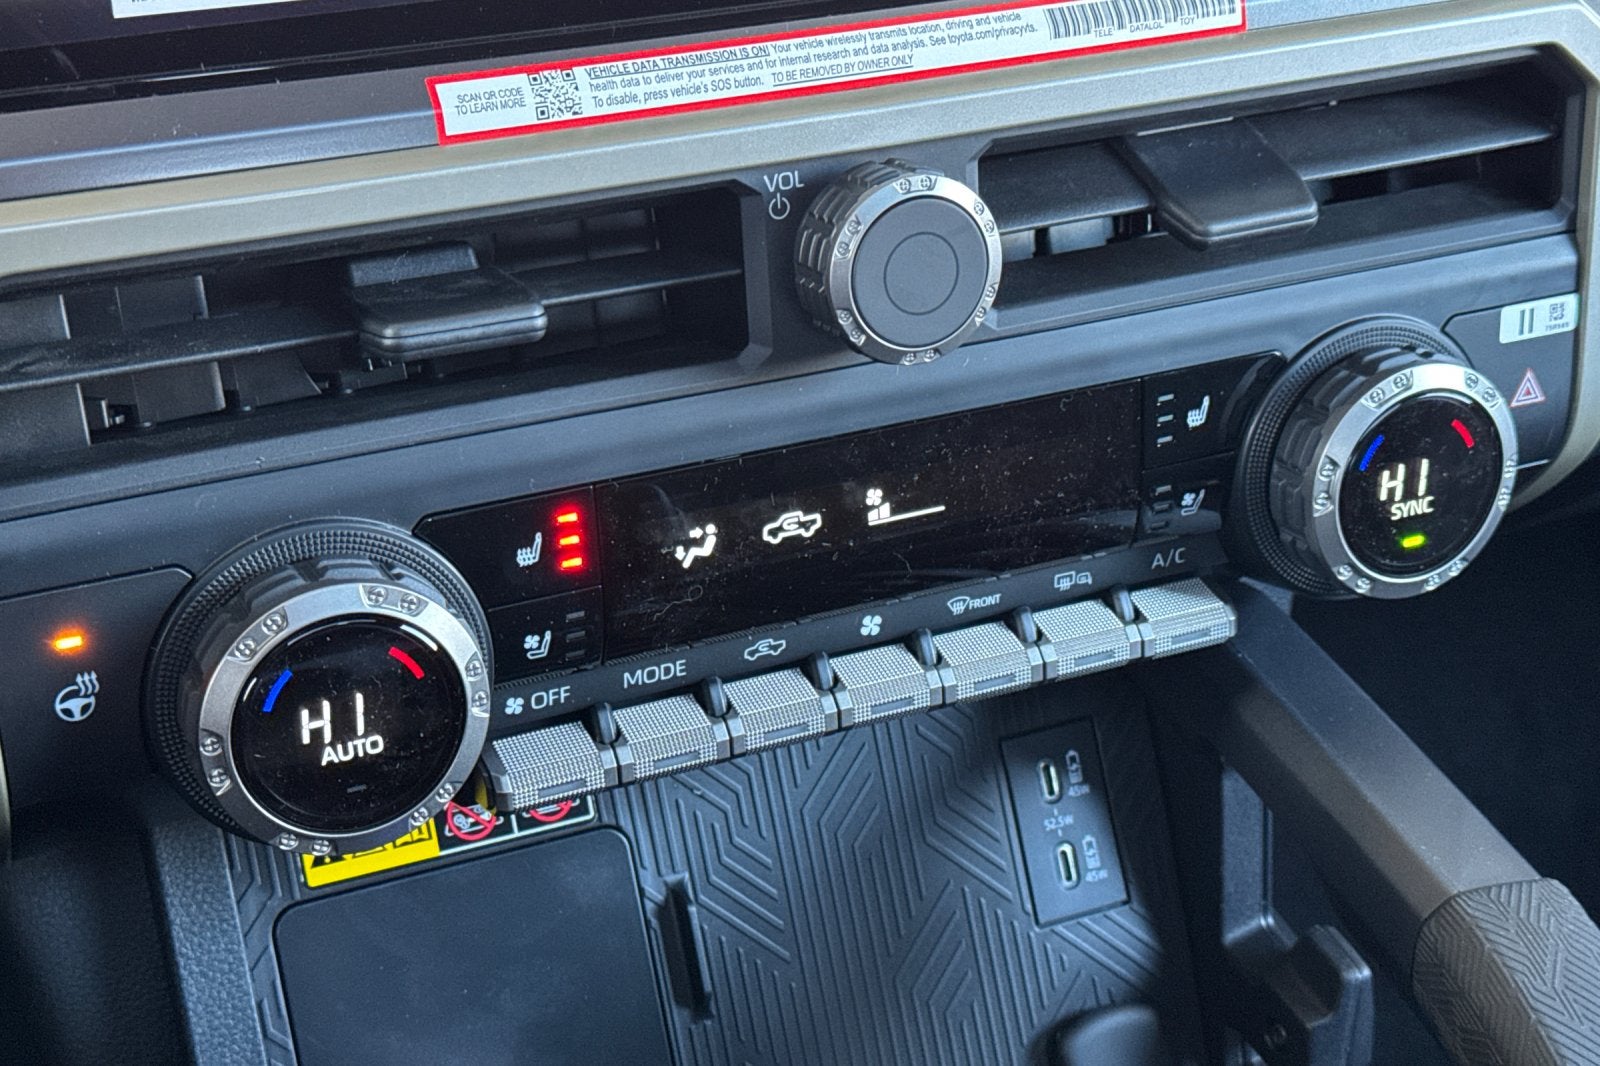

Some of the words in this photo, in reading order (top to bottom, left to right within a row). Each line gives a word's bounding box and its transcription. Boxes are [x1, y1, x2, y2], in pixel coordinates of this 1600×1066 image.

[584, 65, 634, 78] VEHICLE
[632, 61, 659, 73] DATA
[660, 50, 738, 69] TRANSMISSION
[739, 47, 749, 58] IS
[771, 43, 791, 54] Your
[793, 37, 824, 50] vehicle
[825, 32, 867, 47] wirelessly
[868, 26, 908, 41] transmits
[908, 22, 945, 35] location,
[946, 16, 974, 30] driving
[975, 15, 991, 26] and
[992, 12, 1021, 23] vehicle
[1093, 28, 1113, 38] TELE
[589, 78, 618, 93] health
[620, 76, 640, 89] data
[643, 75, 653, 85] to
[654, 70, 684, 84] deliver
[685, 68, 706, 82] your
[708, 62, 745, 77] services
[747, 60, 763, 72] and
[765, 57, 777, 69] for
[778, 53, 812, 67] internal
[813, 48, 850, 62] research
[852, 45, 869, 56] and
[871, 42, 889, 54] data
[891, 39, 928, 52] analysis.
[929, 35, 947, 47] See
[772, 72, 784, 83] TO
[785, 70, 798, 81] BE
[799, 63, 843, 79] REMOVED
[844, 61, 857, 72] BY
[857, 57, 889, 71] OWNER
[891, 54, 914, 66] ONLY
[456, 92, 482, 104] SCAN
[483, 90, 498, 101] QR
[498, 86, 525, 99] CODE
[592, 96, 604, 108] To
[605, 91, 642, 107] disable,
[643, 89, 669, 104] press
[670, 82, 709, 98] vehicle's
[710, 79, 732, 92] SOS
[733, 75, 764, 90] button.
[454, 104, 468, 116] TO
[469, 100, 499, 114] LEARN
[500, 97, 527, 110] MORE
[763, 170, 804, 192] VOL
[1390, 496, 1435, 521] SYNC
[1151, 547, 1187, 570] A/C
[968, 593, 1002, 610] FRONT
[623, 659, 687, 689] MODE
[530, 686, 571, 710] OFF
[320, 734, 385, 767] AUTO
